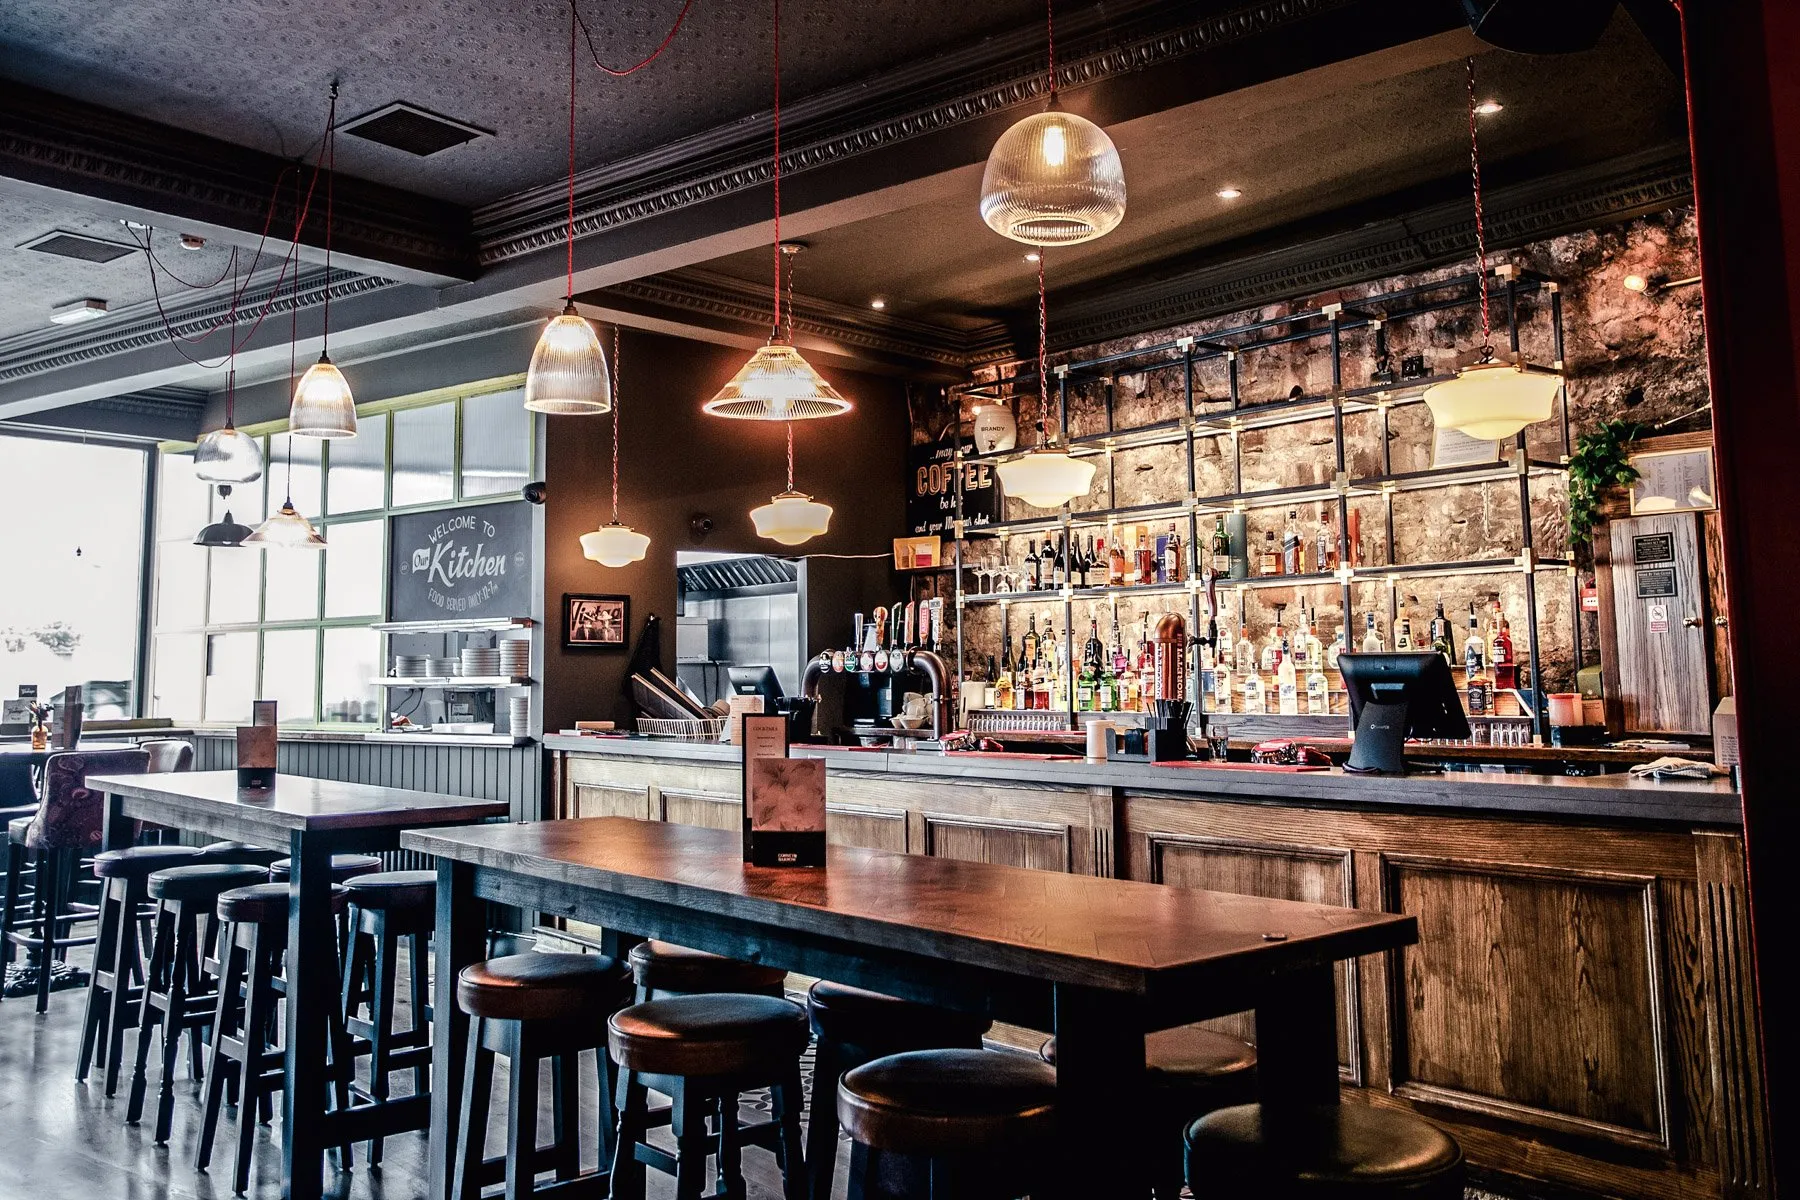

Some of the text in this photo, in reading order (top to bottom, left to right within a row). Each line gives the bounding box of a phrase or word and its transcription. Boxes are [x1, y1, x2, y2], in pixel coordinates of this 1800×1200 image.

[917, 461, 992, 496] COFEE
[940, 496, 949, 510] be
[428, 515, 496, 545] WELCOME TO
[427, 539, 507, 588] Kitchen
[427, 587, 445, 608] FOOD
[446, 596, 467, 612] SERVED
